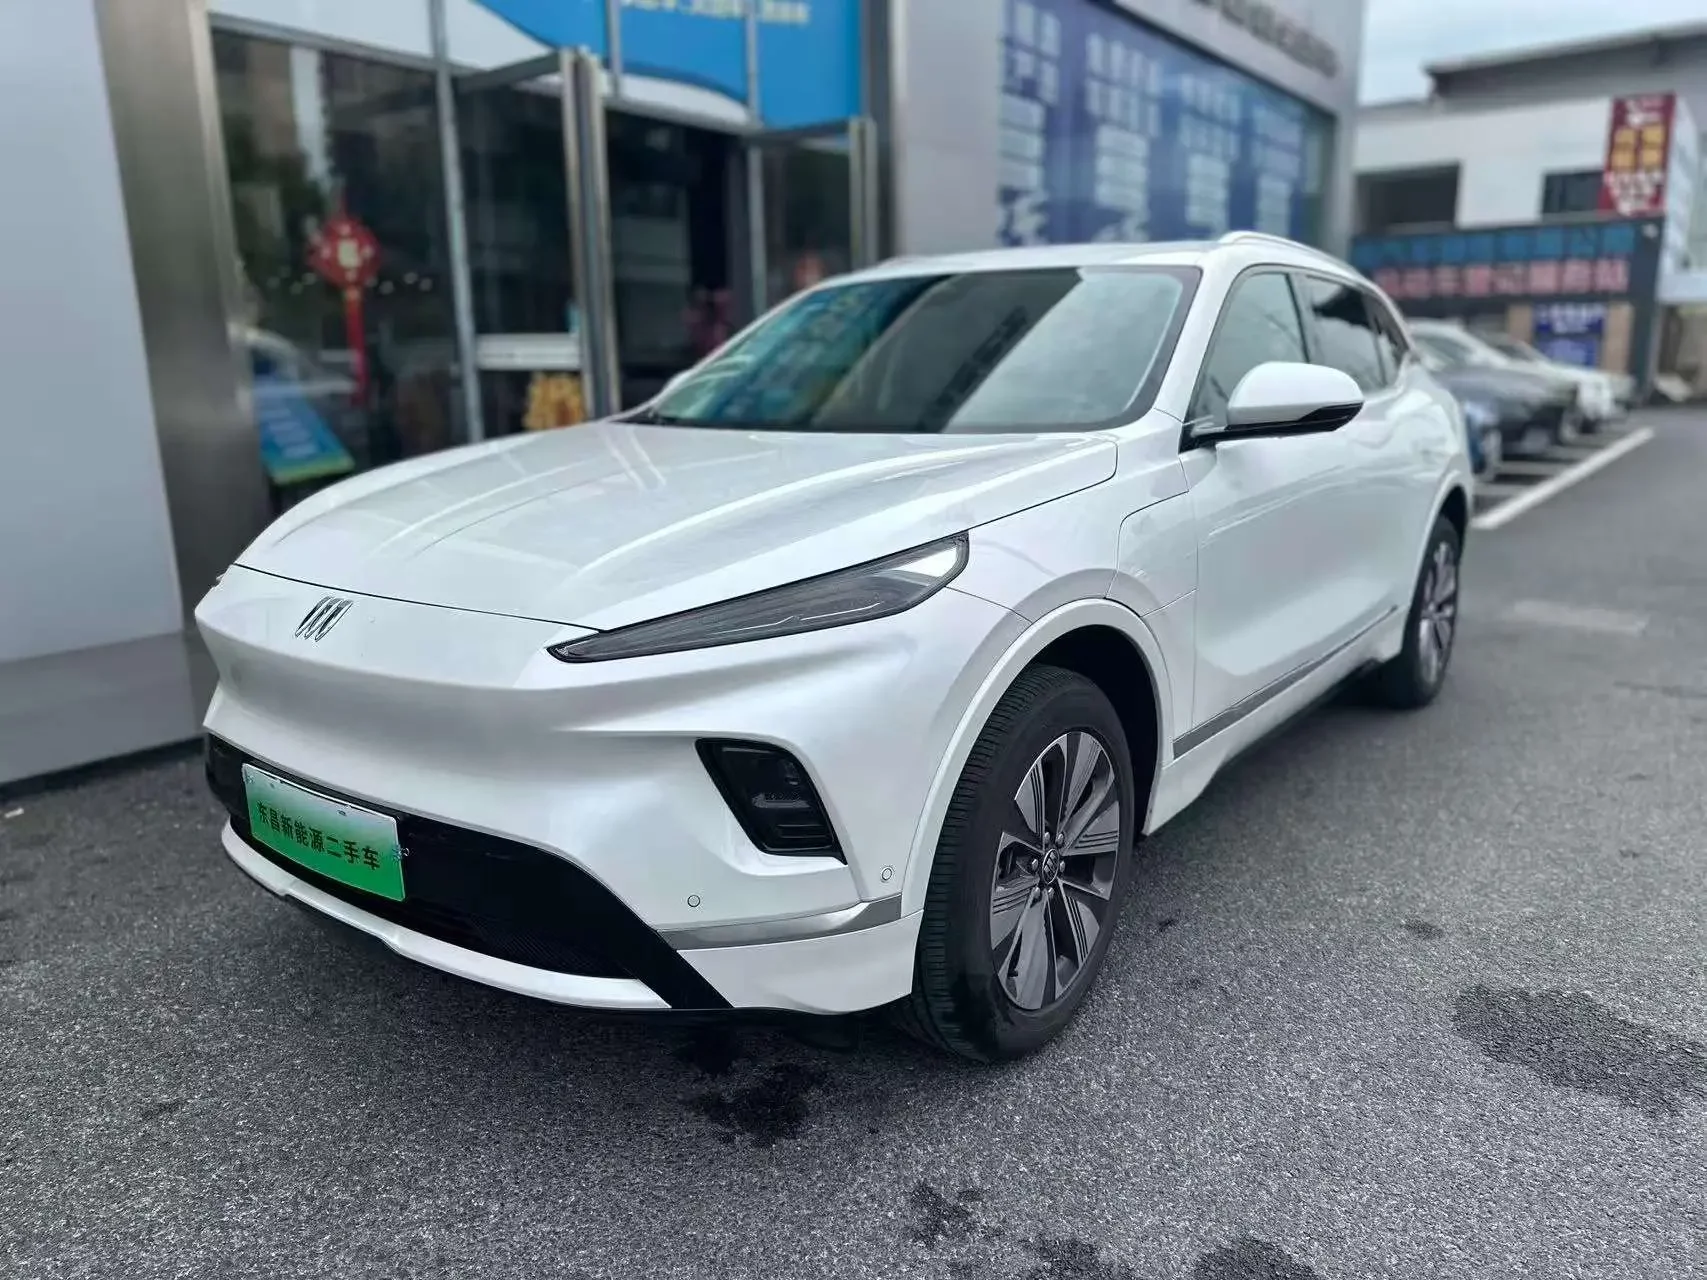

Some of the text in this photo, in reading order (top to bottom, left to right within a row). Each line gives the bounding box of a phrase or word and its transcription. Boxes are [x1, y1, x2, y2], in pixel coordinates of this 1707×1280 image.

[257, 801, 380, 870] 东昌新能源二手车
